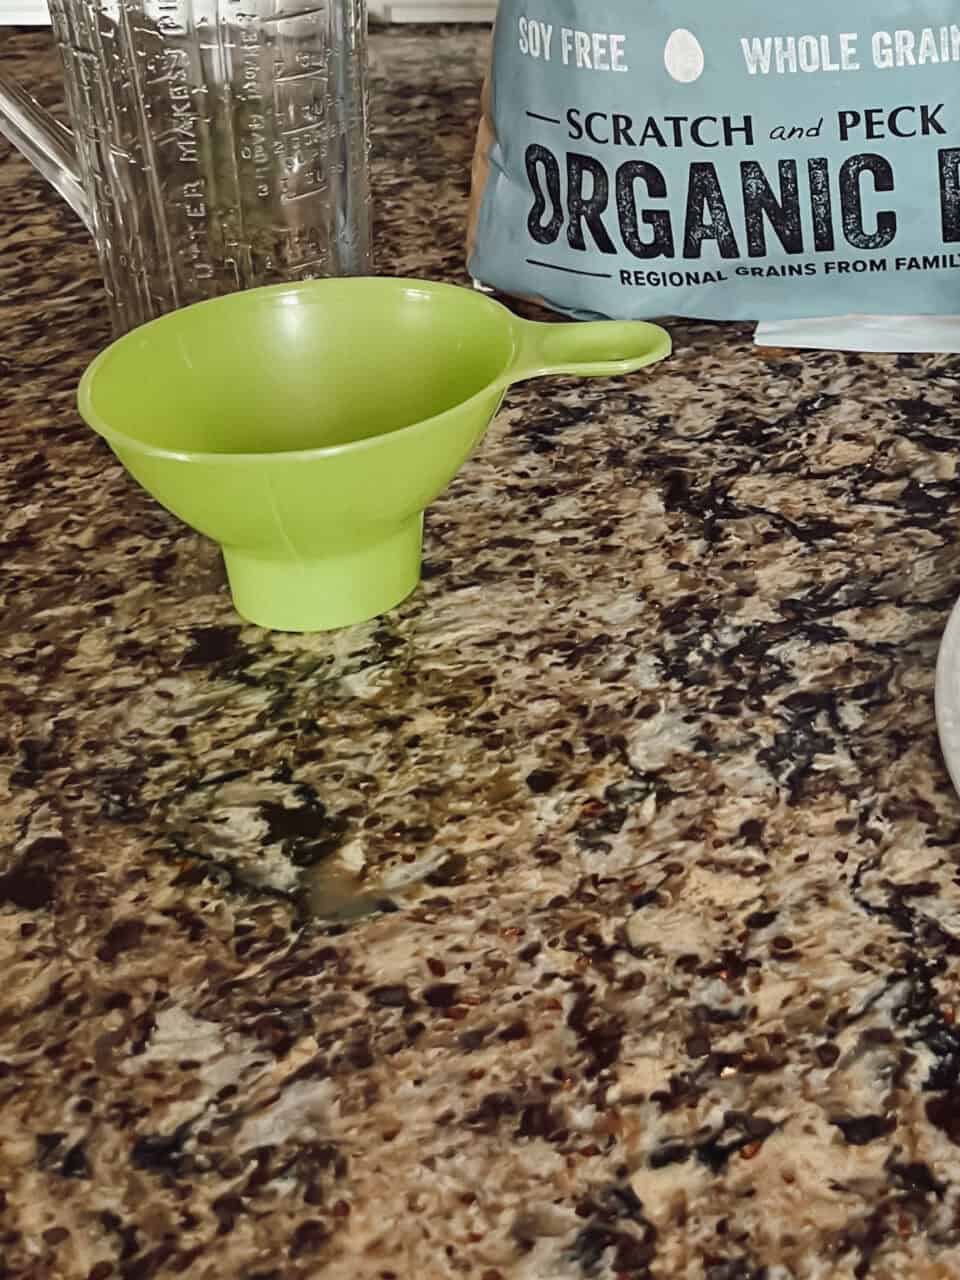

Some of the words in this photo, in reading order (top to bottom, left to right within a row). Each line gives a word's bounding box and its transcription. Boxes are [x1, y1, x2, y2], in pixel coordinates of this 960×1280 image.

[518, 16, 552, 62] SOY
[560, 27, 629, 73] FREE
[740, 32, 860, 75] WHOLE
[566, 107, 754, 147] SCRATCH
[769, 116, 824, 141] and
[838, 103, 947, 141] PECK
[524, 142, 897, 261] ORGANIC
[619, 269, 728, 288] REGIONAL
[735, 263, 817, 278] GRAINS
[824, 258, 888, 275] FROM
